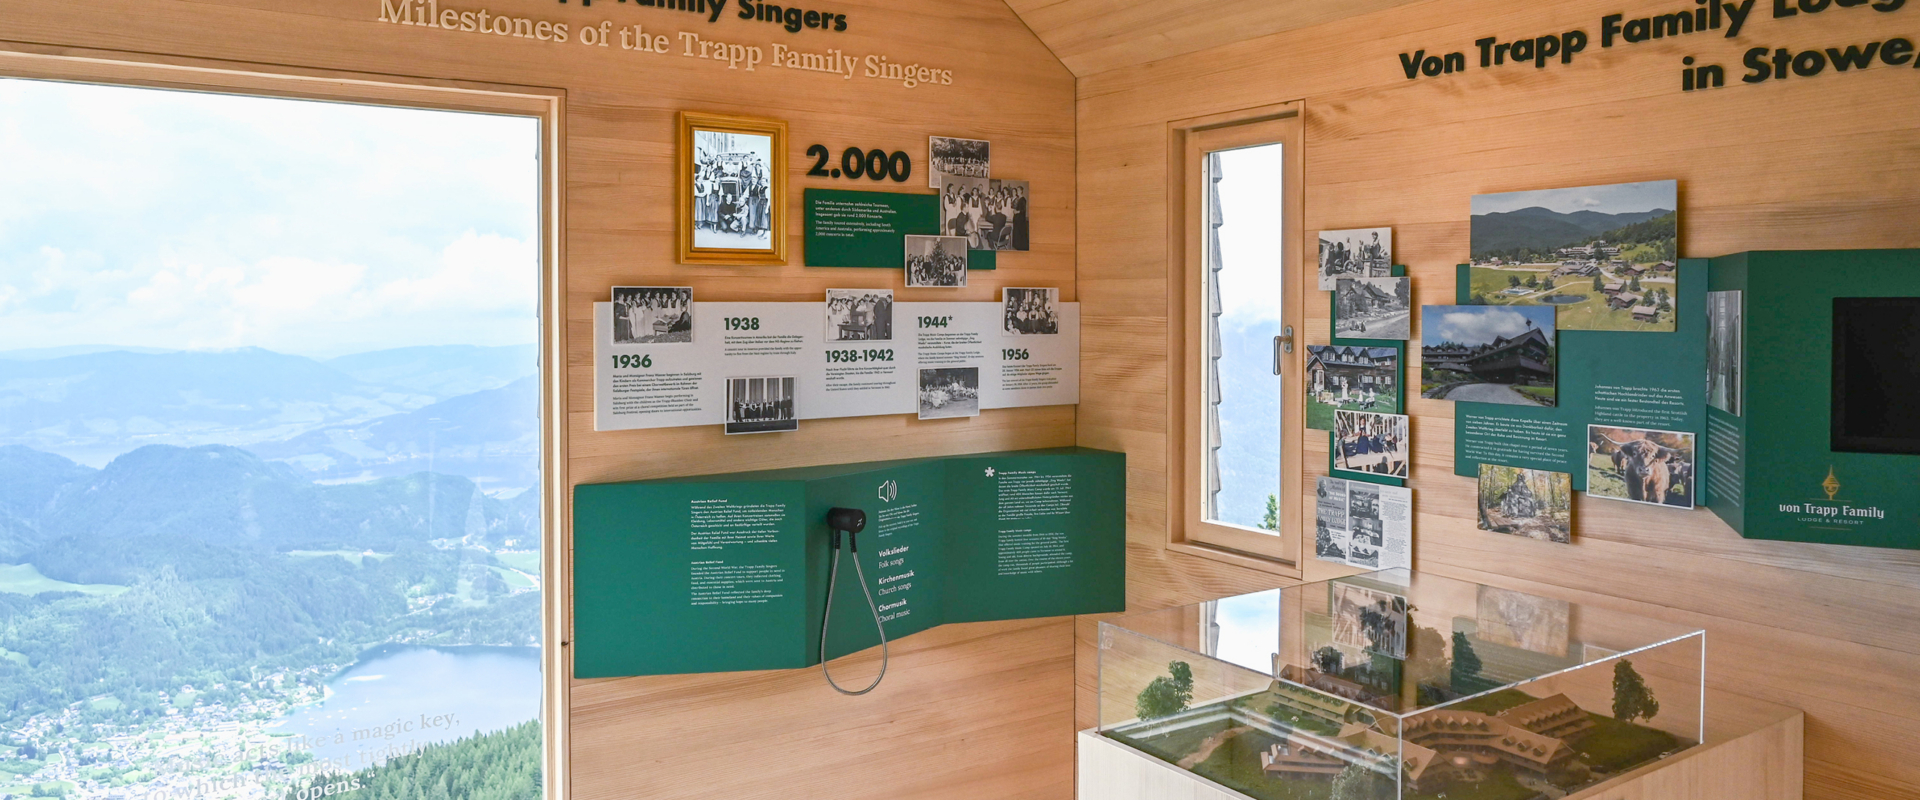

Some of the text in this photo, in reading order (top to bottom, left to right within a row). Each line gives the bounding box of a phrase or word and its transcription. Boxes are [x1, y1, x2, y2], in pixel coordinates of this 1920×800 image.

[738, 0, 847, 32] Singers
[378, 0, 568, 42] Milestones
[580, 20, 612, 46] of
[619, 24, 669, 53] the
[678, 32, 762, 71] Trapp
[772, 43, 858, 79] Family
[865, 55, 952, 88] Singers
[1398, 50, 1464, 79] Von
[1475, 30, 1587, 68] Trapp
[1602, 0, 1755, 47] Family
[1682, 56, 1724, 90] in
[806, 144, 911, 182] 2.000
[724, 317, 760, 330] 1938
[612, 354, 652, 368] 1936
[825, 349, 894, 362] 1938-1942
[1002, 348, 1029, 360] 1956
[1780, 503, 1884, 519] von Trapp Family
[878, 545, 909, 557] Volkslieder
[878, 558, 904, 569] Folk songs
[878, 570, 915, 585] Kirchenmusik
[878, 582, 912, 596] Church songs
[878, 598, 907, 612] Chormusik
[878, 609, 910, 623] Choral music
[234, 742, 279, 762] acts
[287, 735, 326, 752] like
[334, 733, 344, 744] a
[353, 718, 413, 740] magic
[420, 713, 460, 730] key,
[176, 772, 246, 798] which
[299, 753, 352, 776] most
[360, 739, 427, 766] tightly
